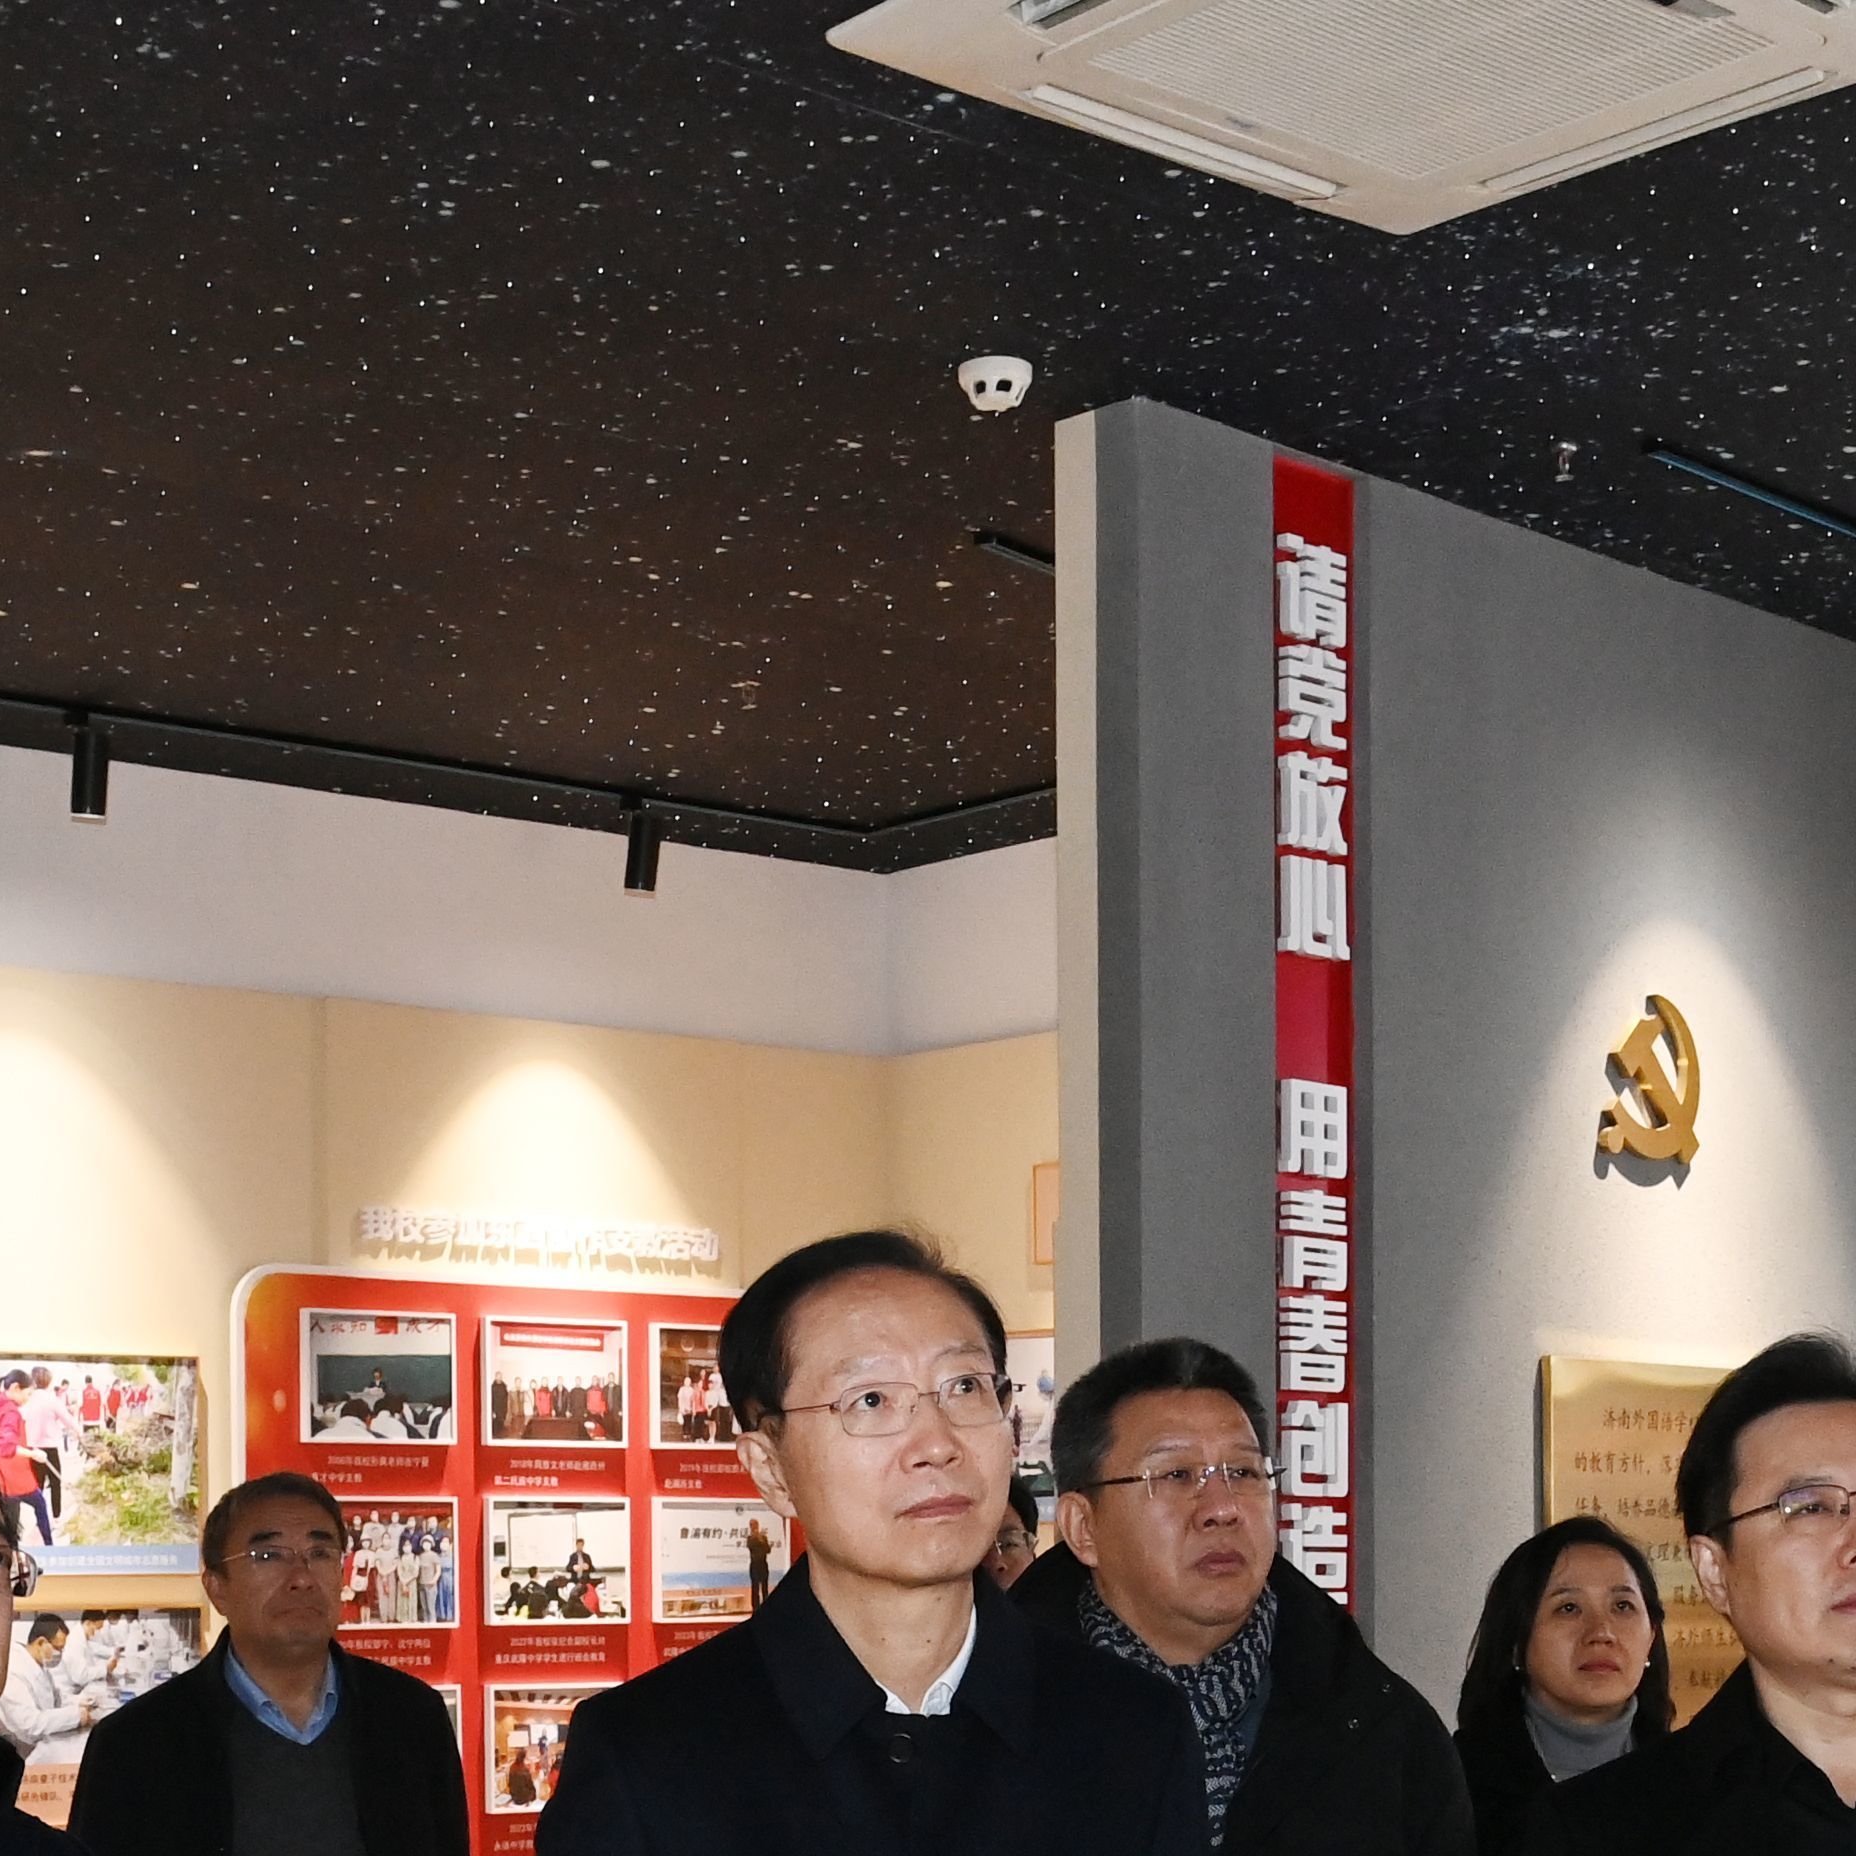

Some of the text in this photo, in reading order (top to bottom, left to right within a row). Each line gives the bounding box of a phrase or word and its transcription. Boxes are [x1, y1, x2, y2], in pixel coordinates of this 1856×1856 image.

[1277, 533, 1350, 961] 请党放心
[1574, 1450, 1682, 1475] 的教育方针，落
